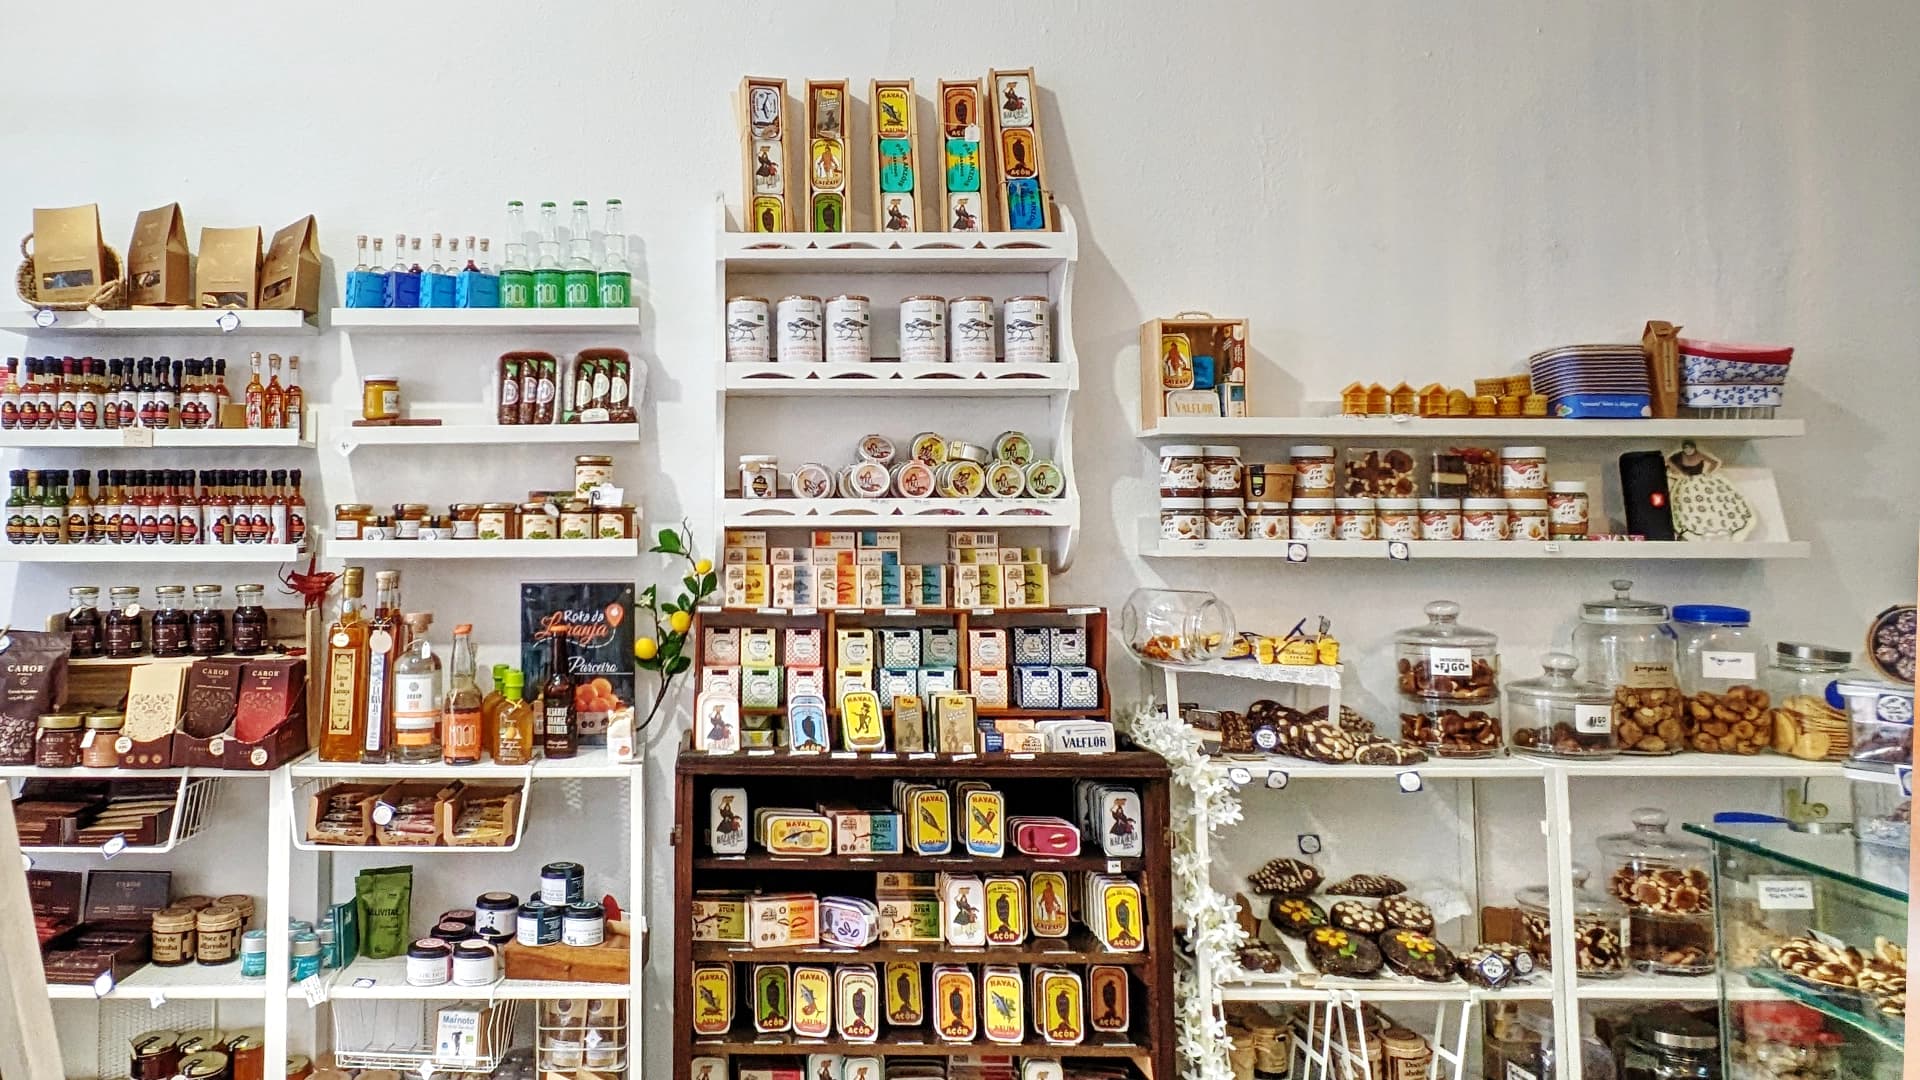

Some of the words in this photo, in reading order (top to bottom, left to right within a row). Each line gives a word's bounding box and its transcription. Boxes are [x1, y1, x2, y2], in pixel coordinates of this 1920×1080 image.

[564, 609, 590, 623] Rota
[591, 609, 604, 622] da
[534, 611, 609, 645] Lranja
[7, 664, 45, 673] CAROB
[202, 667, 230, 676] CAROB
[1062, 735, 1107, 749] VALFLOR
[971, 796, 998, 805] NAVAL
[785, 820, 811, 828] NAVAL
[699, 974, 725, 982] NAVAL
[800, 974, 825, 983] NAVAL
[990, 980, 1017, 988] NAVAL
[442, 1014, 475, 1025] Marnoto
